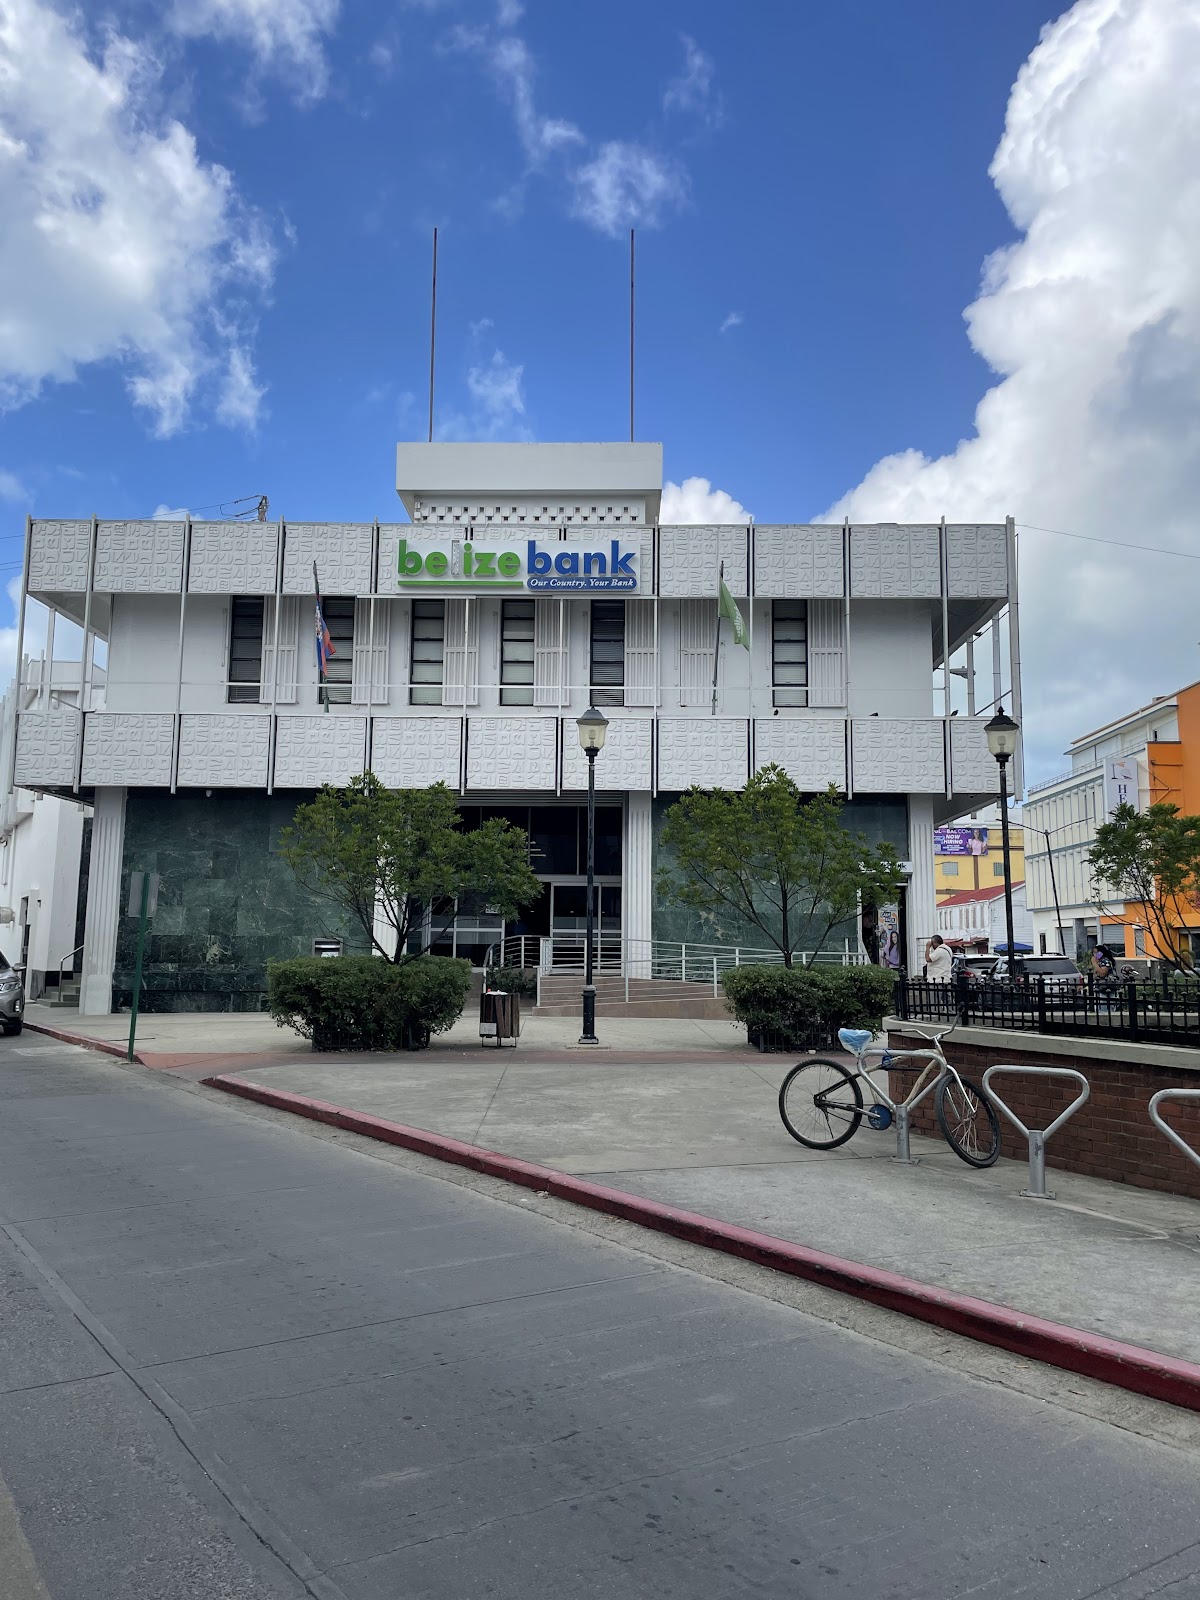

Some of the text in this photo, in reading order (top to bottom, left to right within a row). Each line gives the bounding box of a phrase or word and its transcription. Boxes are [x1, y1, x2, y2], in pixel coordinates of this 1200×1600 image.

[398, 539, 637, 576] belize bank
[530, 578, 548, 587] Our
[589, 578, 609, 587] Your
[610, 578, 634, 587] Bank
